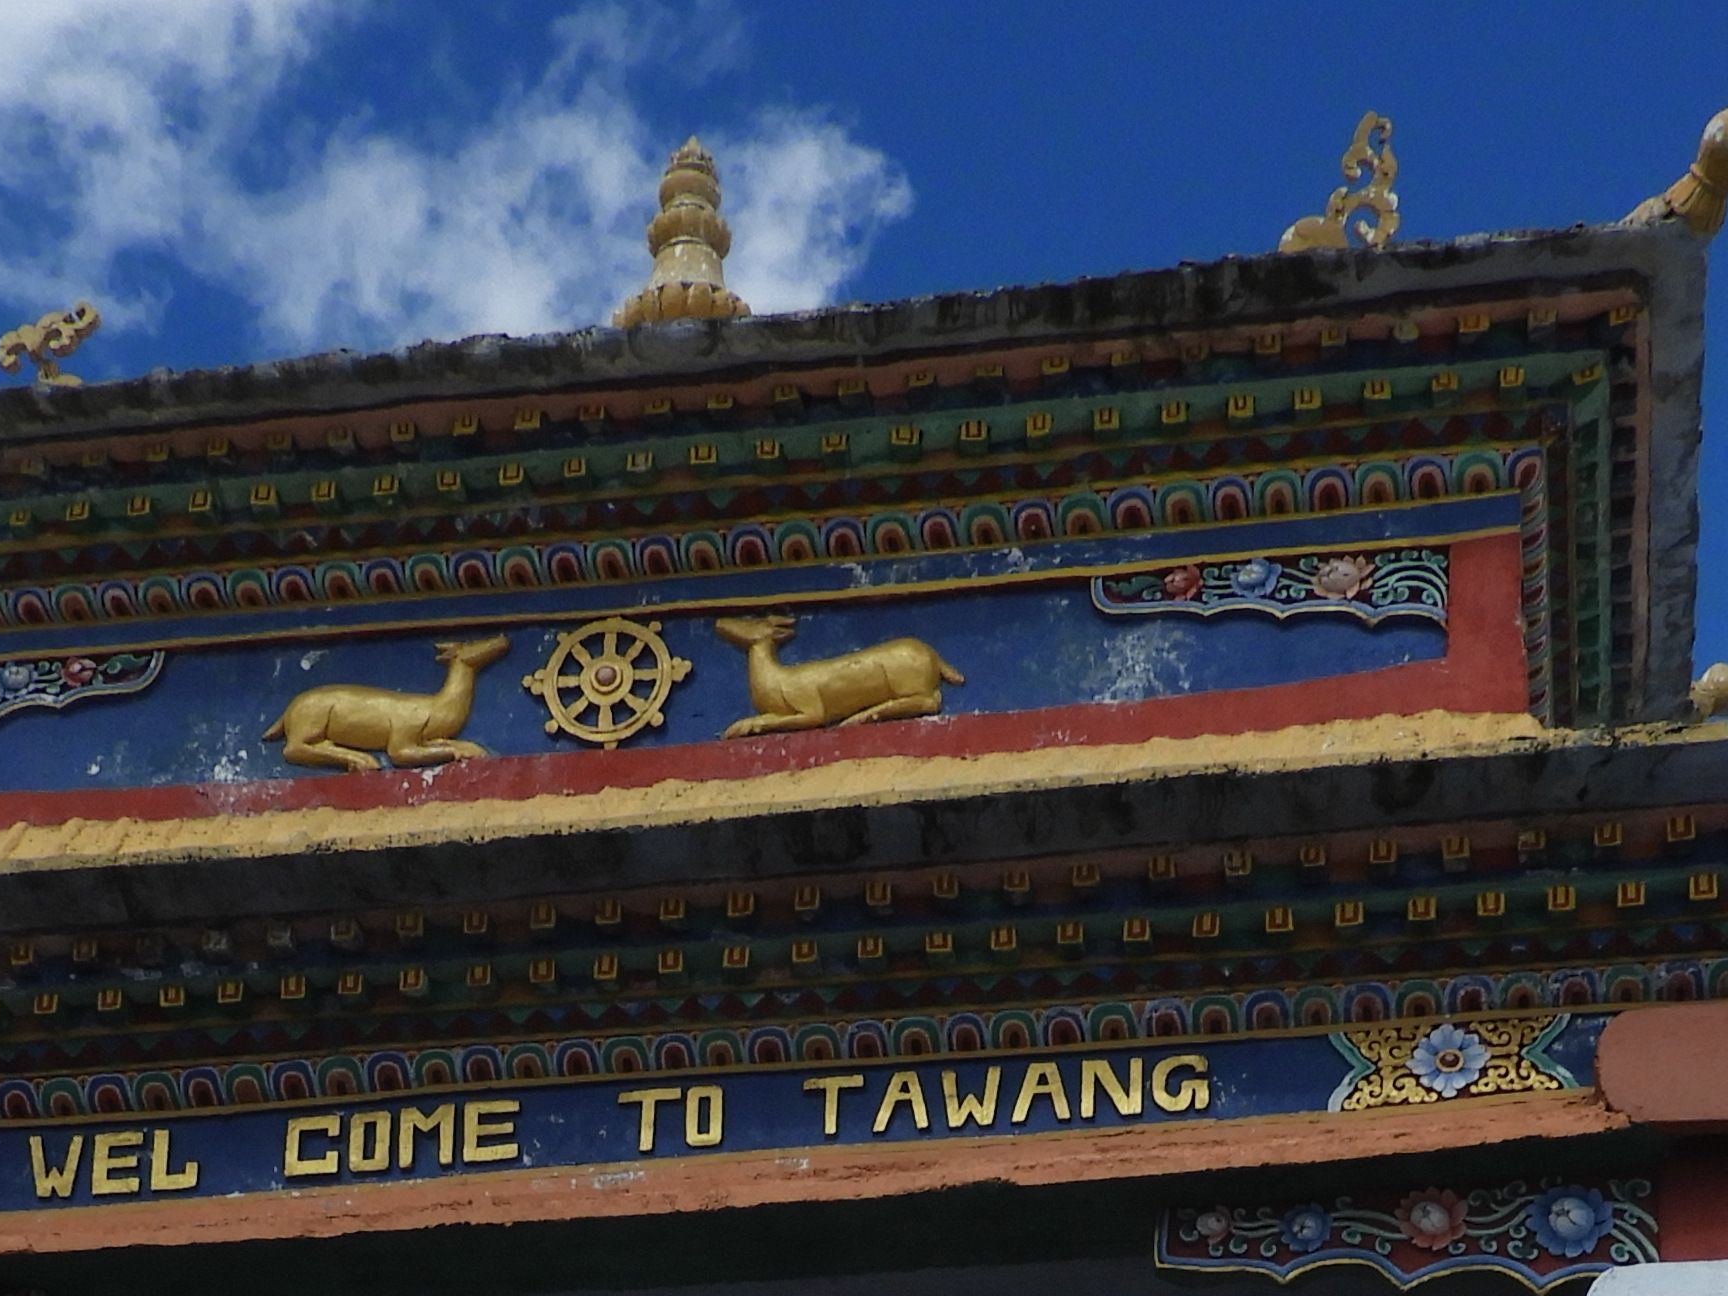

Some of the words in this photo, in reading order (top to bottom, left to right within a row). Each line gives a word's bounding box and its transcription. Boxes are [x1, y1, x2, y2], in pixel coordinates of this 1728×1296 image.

[27, 1131, 198, 1199] WEL
[283, 1099, 523, 1178] COME
[618, 1083, 724, 1154] TO
[802, 1053, 1210, 1136] TAWANG
